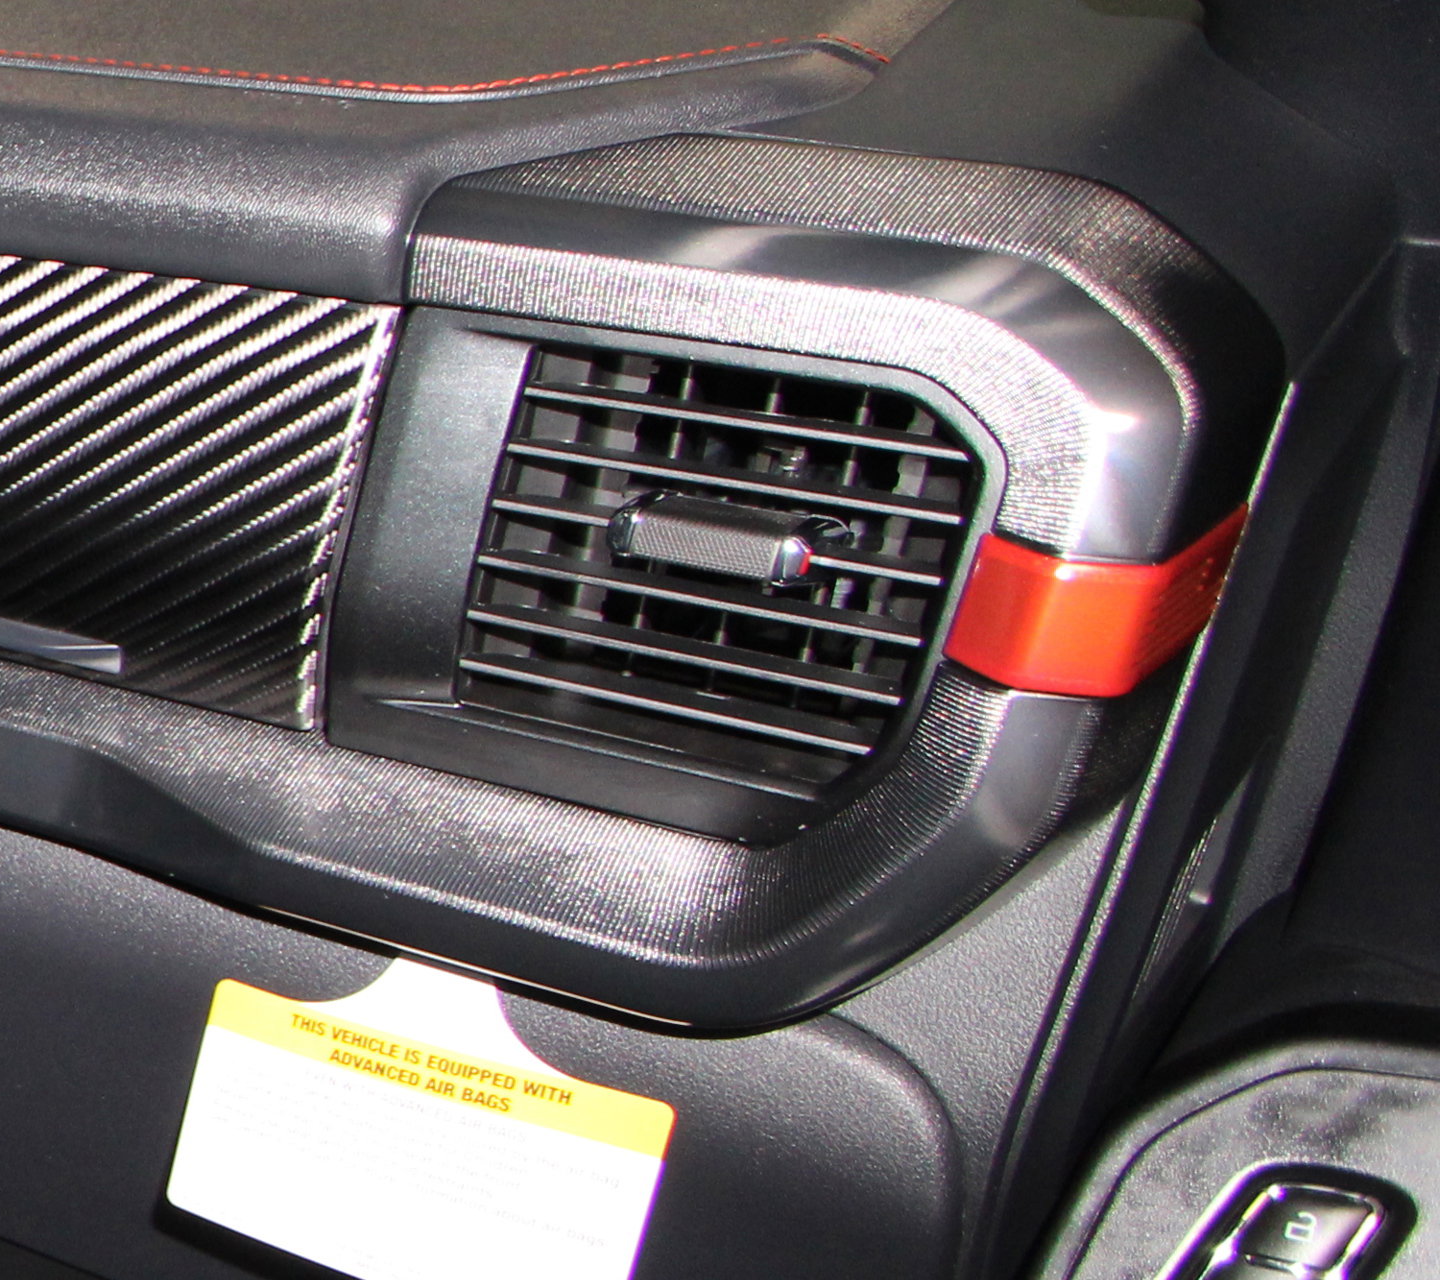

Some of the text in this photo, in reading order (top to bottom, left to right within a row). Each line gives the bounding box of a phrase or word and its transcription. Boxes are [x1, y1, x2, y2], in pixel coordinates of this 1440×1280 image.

[292, 1013, 573, 1106] THIS VEHICLE IS EQUIPPED WITH
[329, 1049, 511, 1112] ADVANCED AIR BAGS
